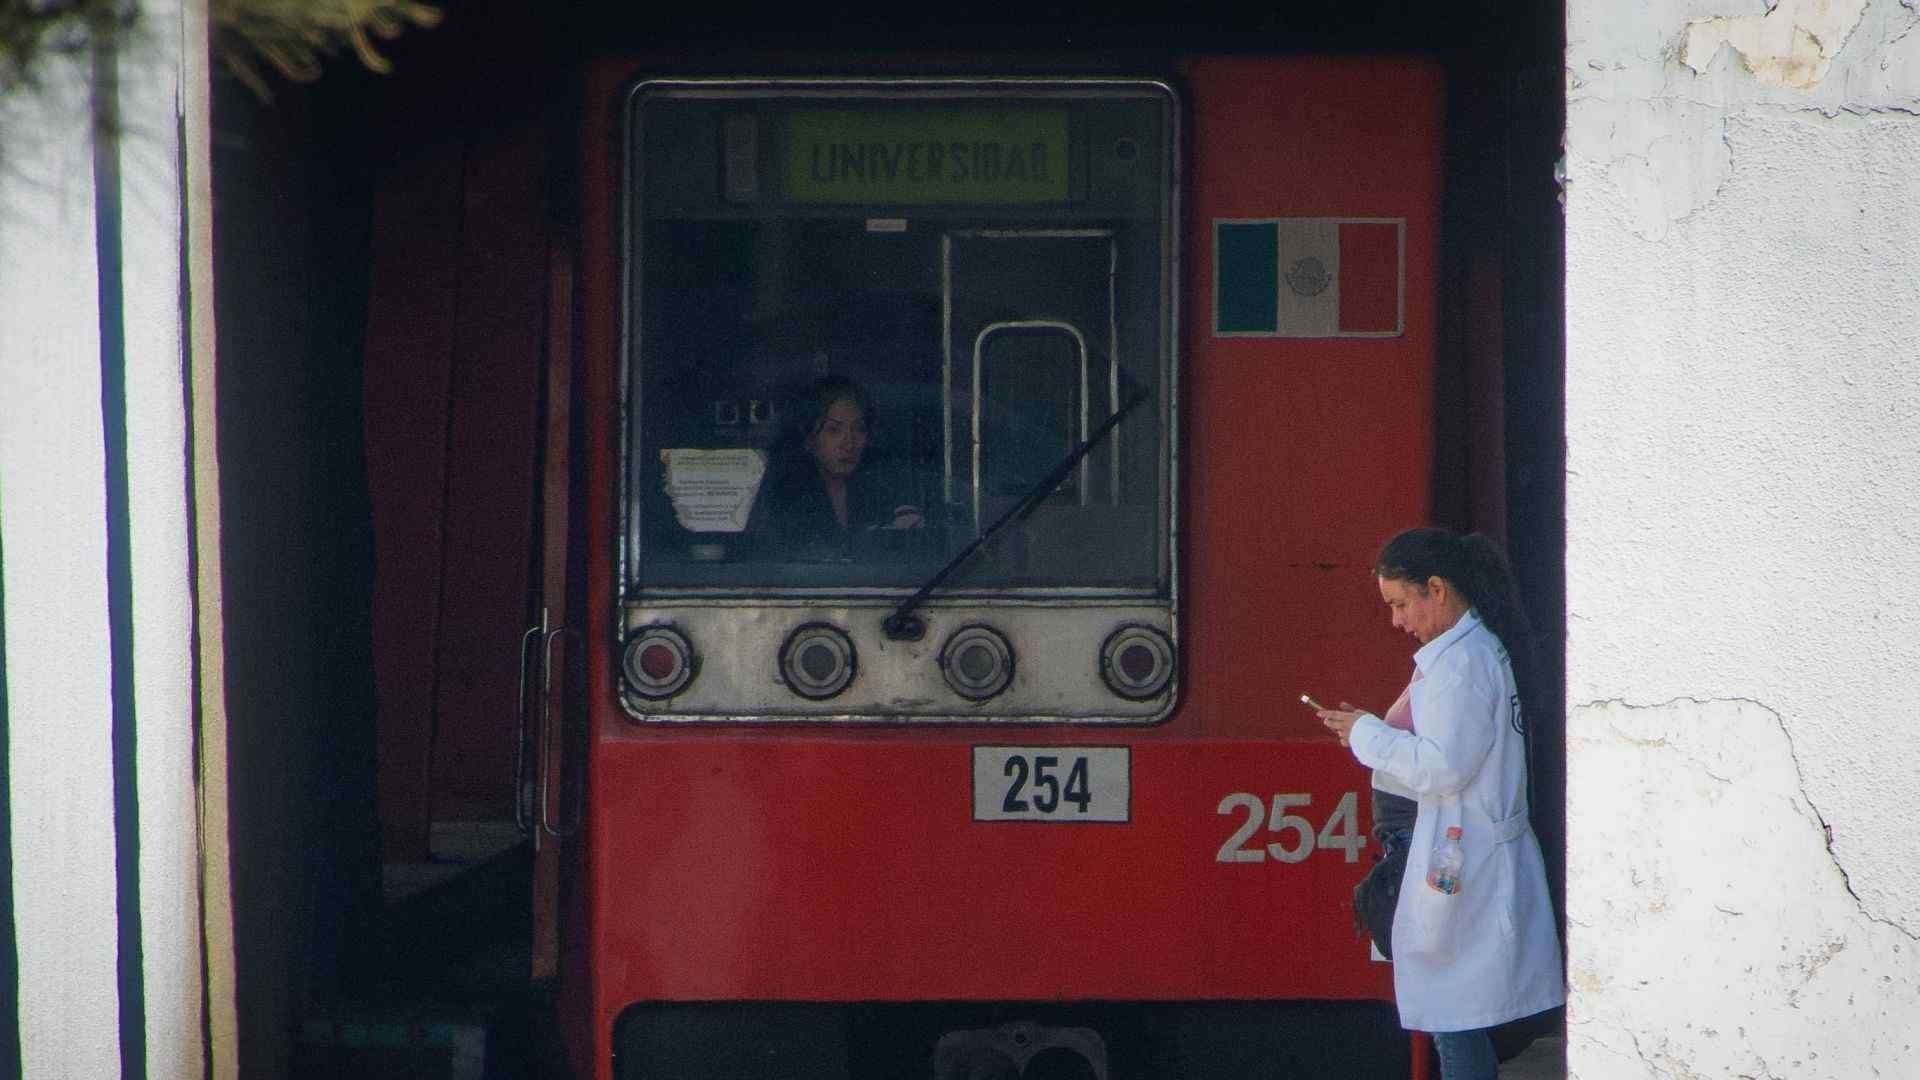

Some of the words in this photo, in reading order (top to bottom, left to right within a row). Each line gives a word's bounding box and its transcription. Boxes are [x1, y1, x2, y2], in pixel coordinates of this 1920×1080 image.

[811, 142, 1050, 183] UNIVERSIDAD
[1003, 754, 1092, 813] 254
[1217, 791, 1367, 863] 254
